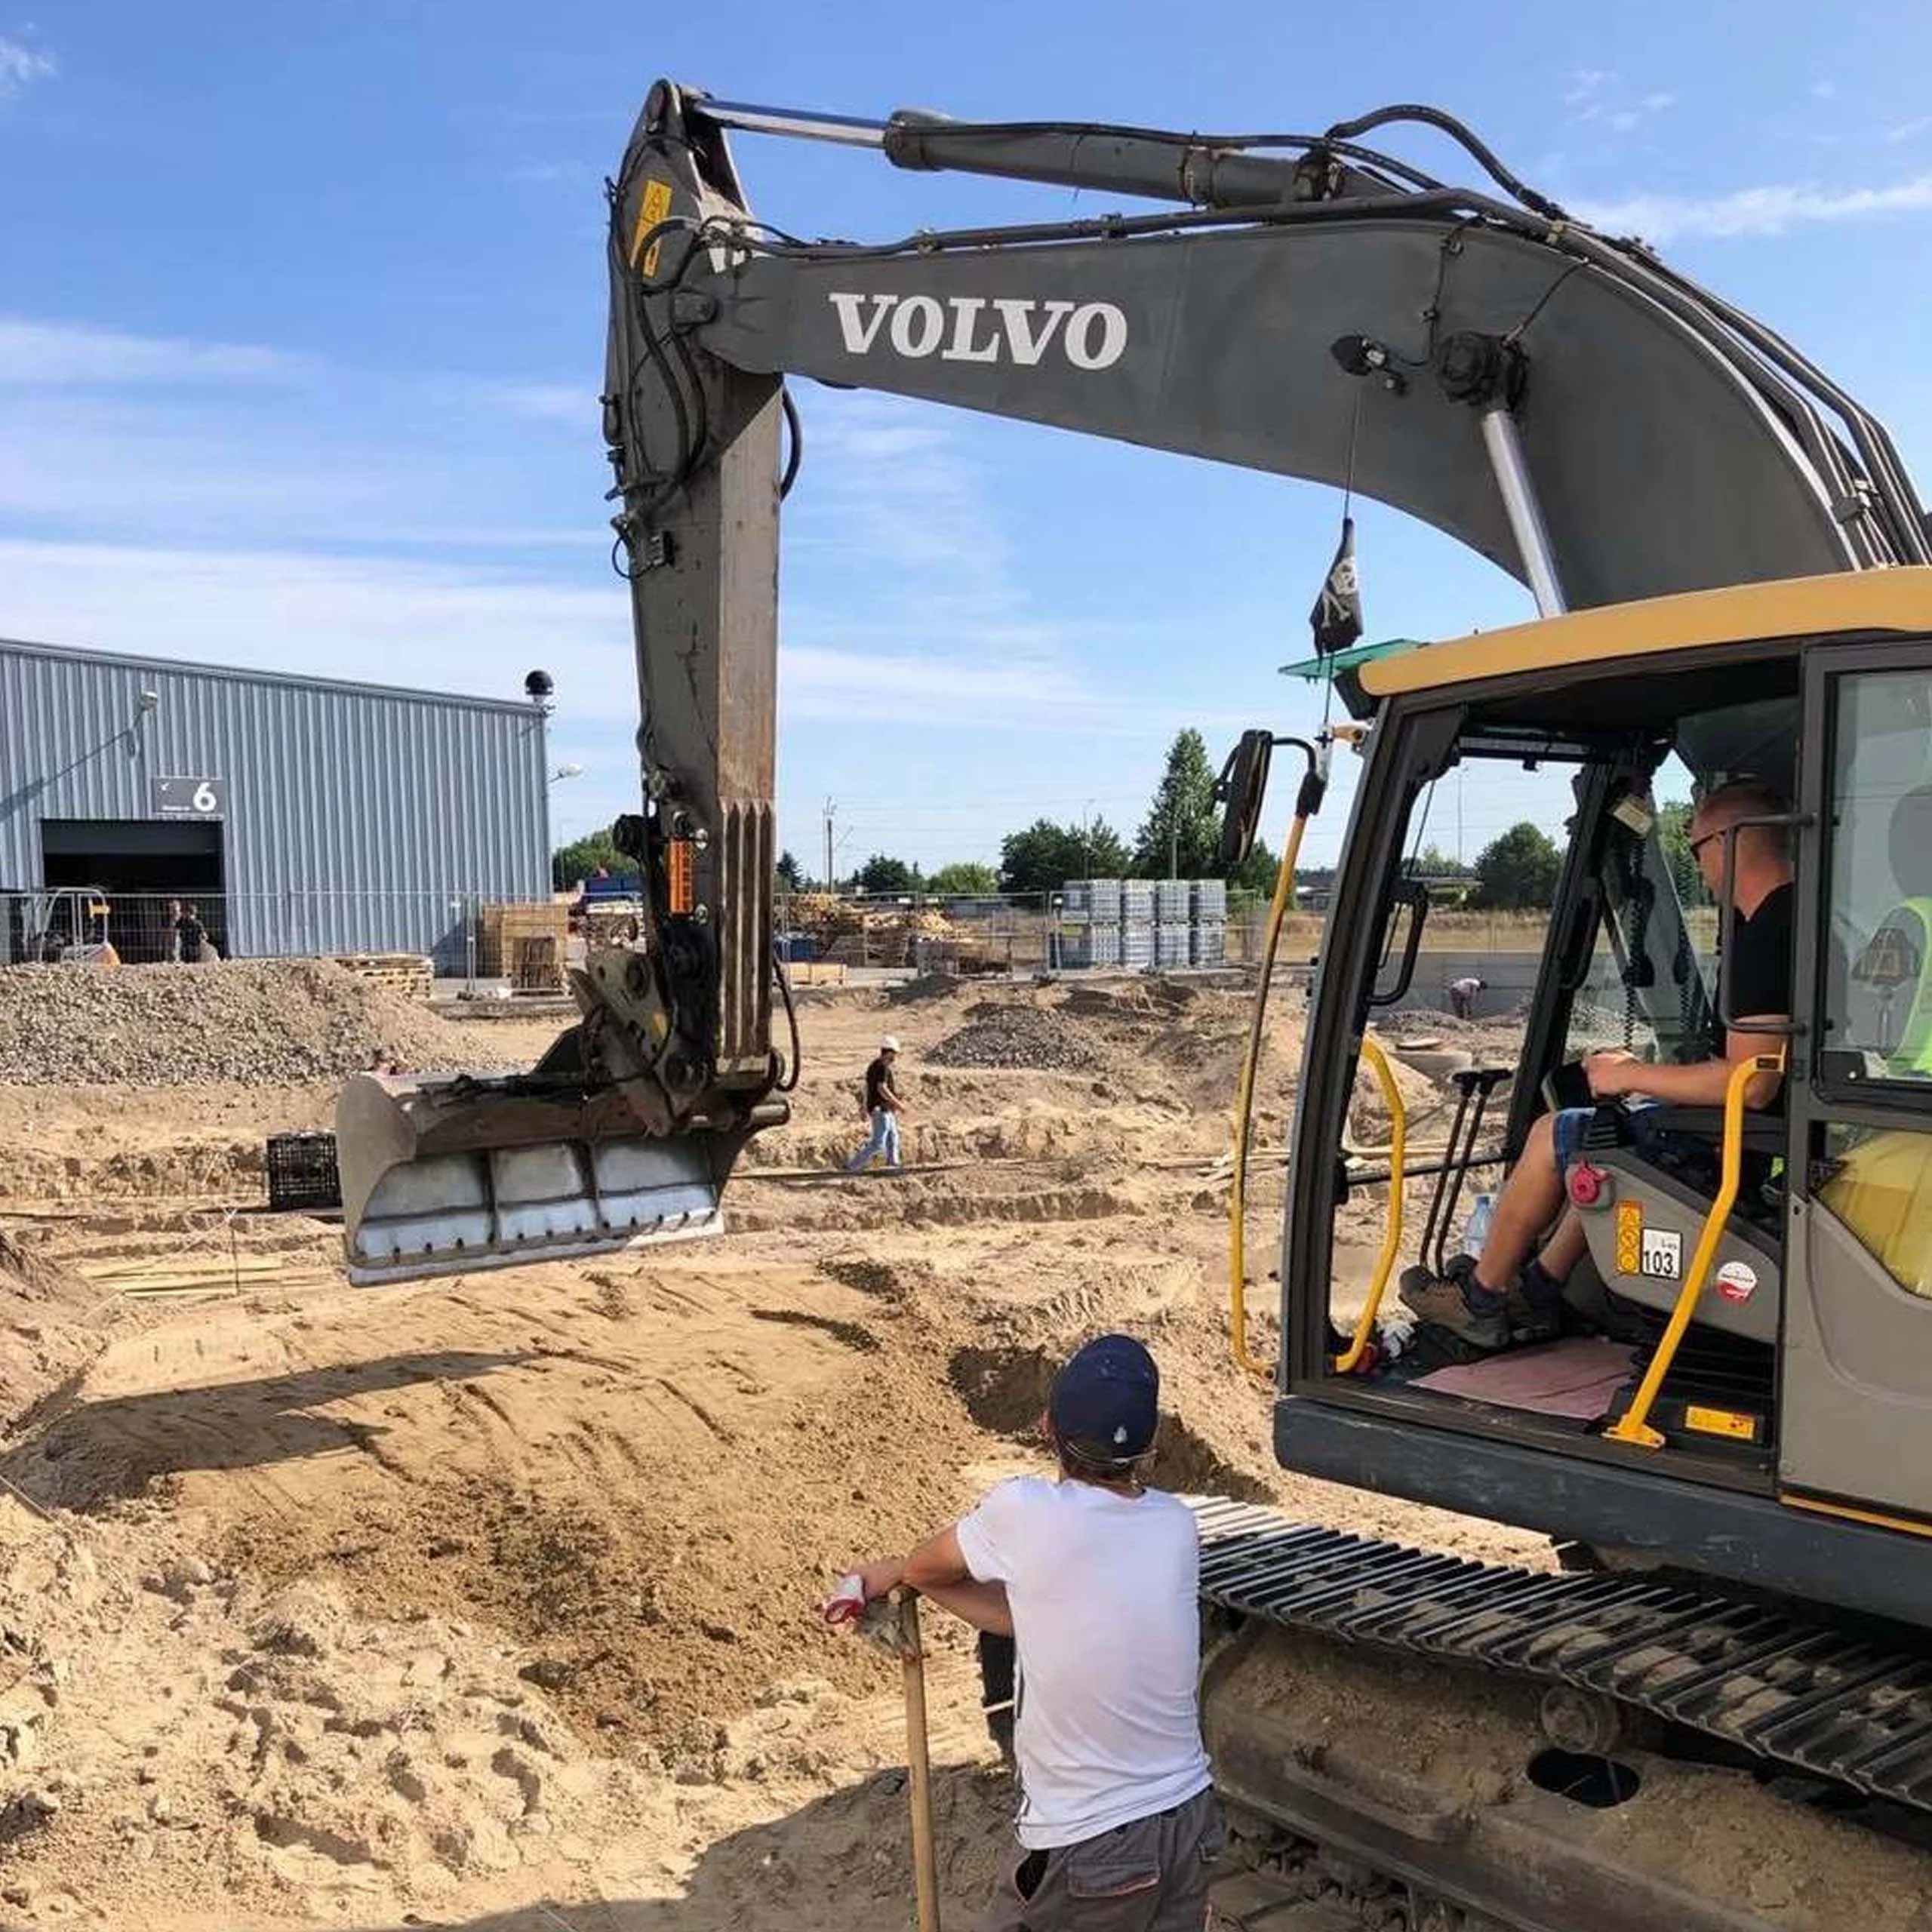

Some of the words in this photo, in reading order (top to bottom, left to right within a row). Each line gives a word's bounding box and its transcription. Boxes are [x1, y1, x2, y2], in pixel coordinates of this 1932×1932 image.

[829, 293, 1128, 370] VOLVO
[193, 782, 217, 811] 6
[1644, 1251, 1673, 1274] 103
